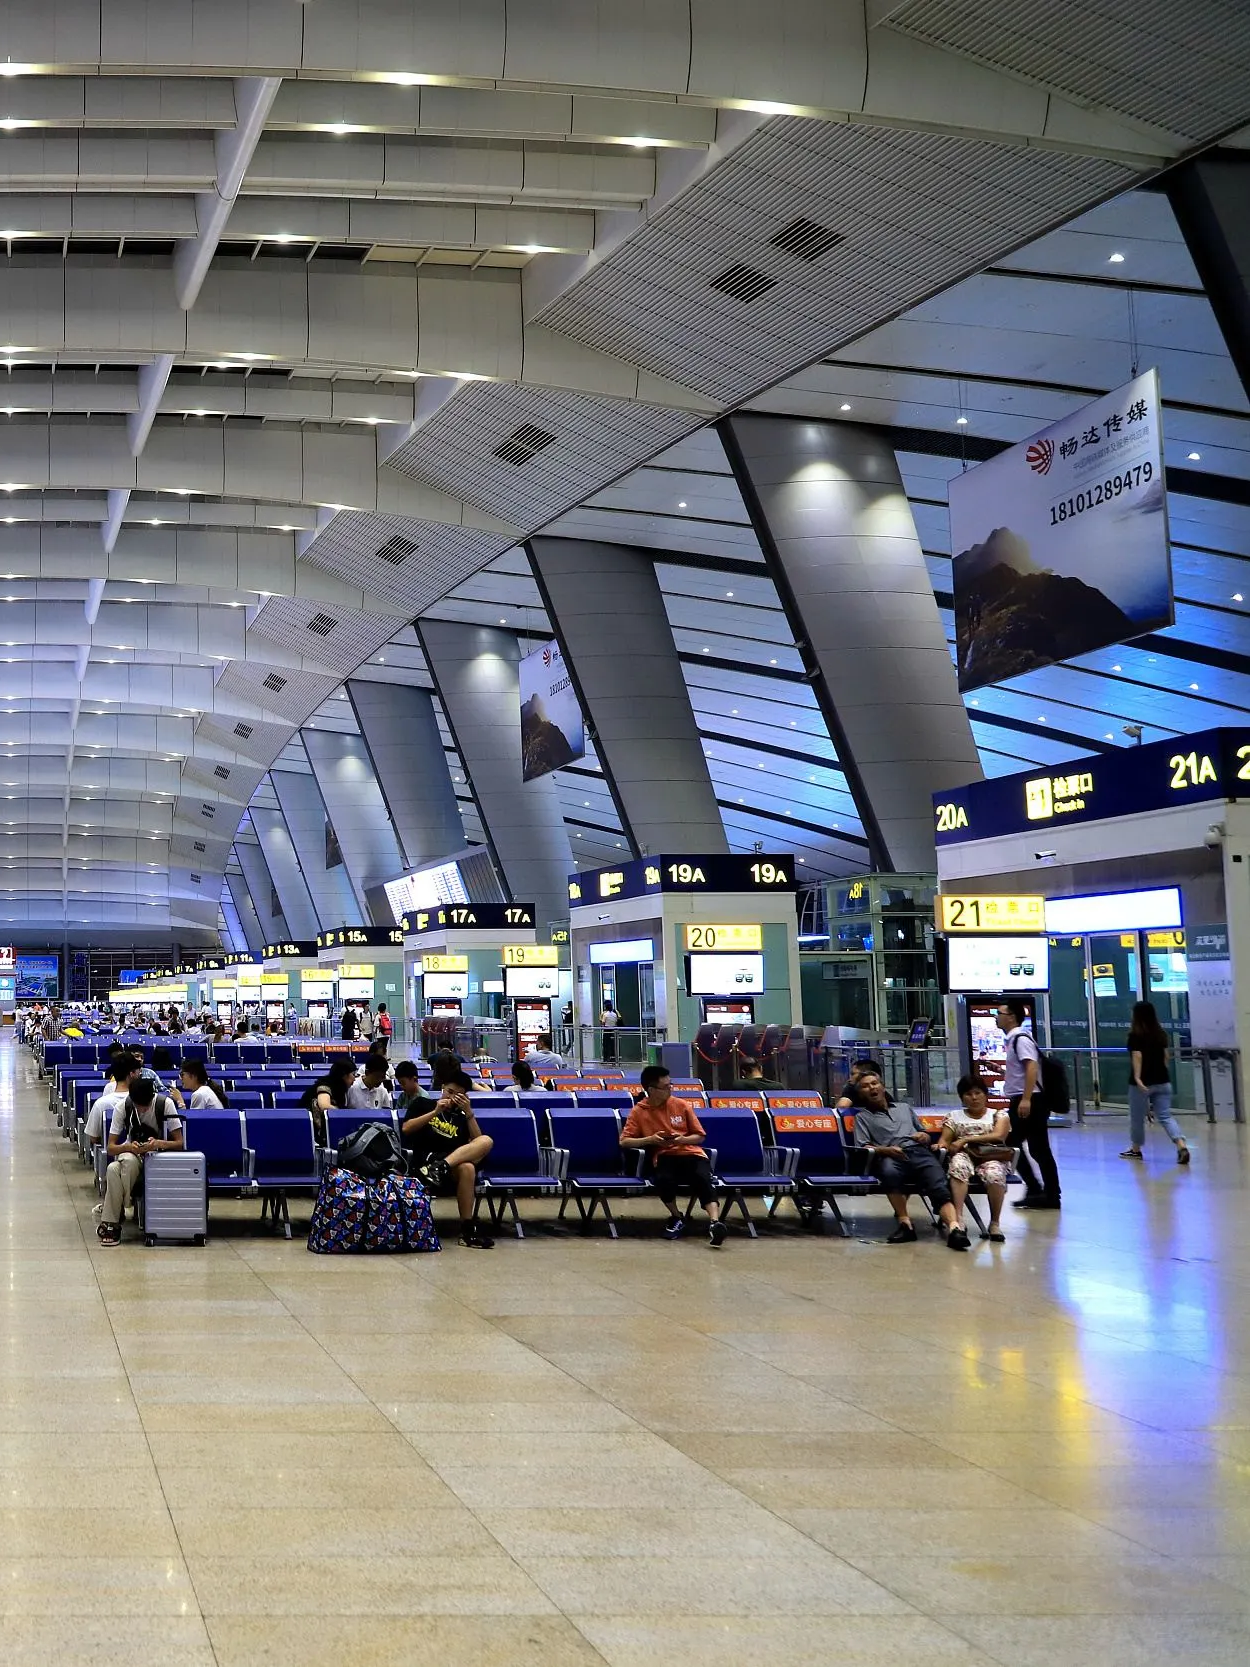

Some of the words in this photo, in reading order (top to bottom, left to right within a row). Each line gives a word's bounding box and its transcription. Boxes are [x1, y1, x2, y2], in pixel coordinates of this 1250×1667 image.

[1059, 399, 1148, 460] 畅达传媒
[1050, 462, 1153, 526] 18101289479
[1170, 752, 1218, 789] 21A
[1053, 773, 1093, 800] 检票口
[1054, 801, 1075, 814] Check
[936, 804, 969, 831] 20A
[669, 864, 705, 883] 19A
[750, 864, 787, 883] 19A
[450, 908, 477, 924] 17A
[504, 908, 531, 923] 17A
[950, 900, 980, 927] 21
[347, 930, 368, 943] 15A
[691, 927, 716, 947] 20
[283, 944, 300, 955] 13A
[509, 948, 525, 963] 19
[341, 966, 352, 976] 17
[425, 957, 440, 969] 18
[728, 1101, 759, 1109] 爱心专座
[796, 1119, 832, 1129] 爱心专座
